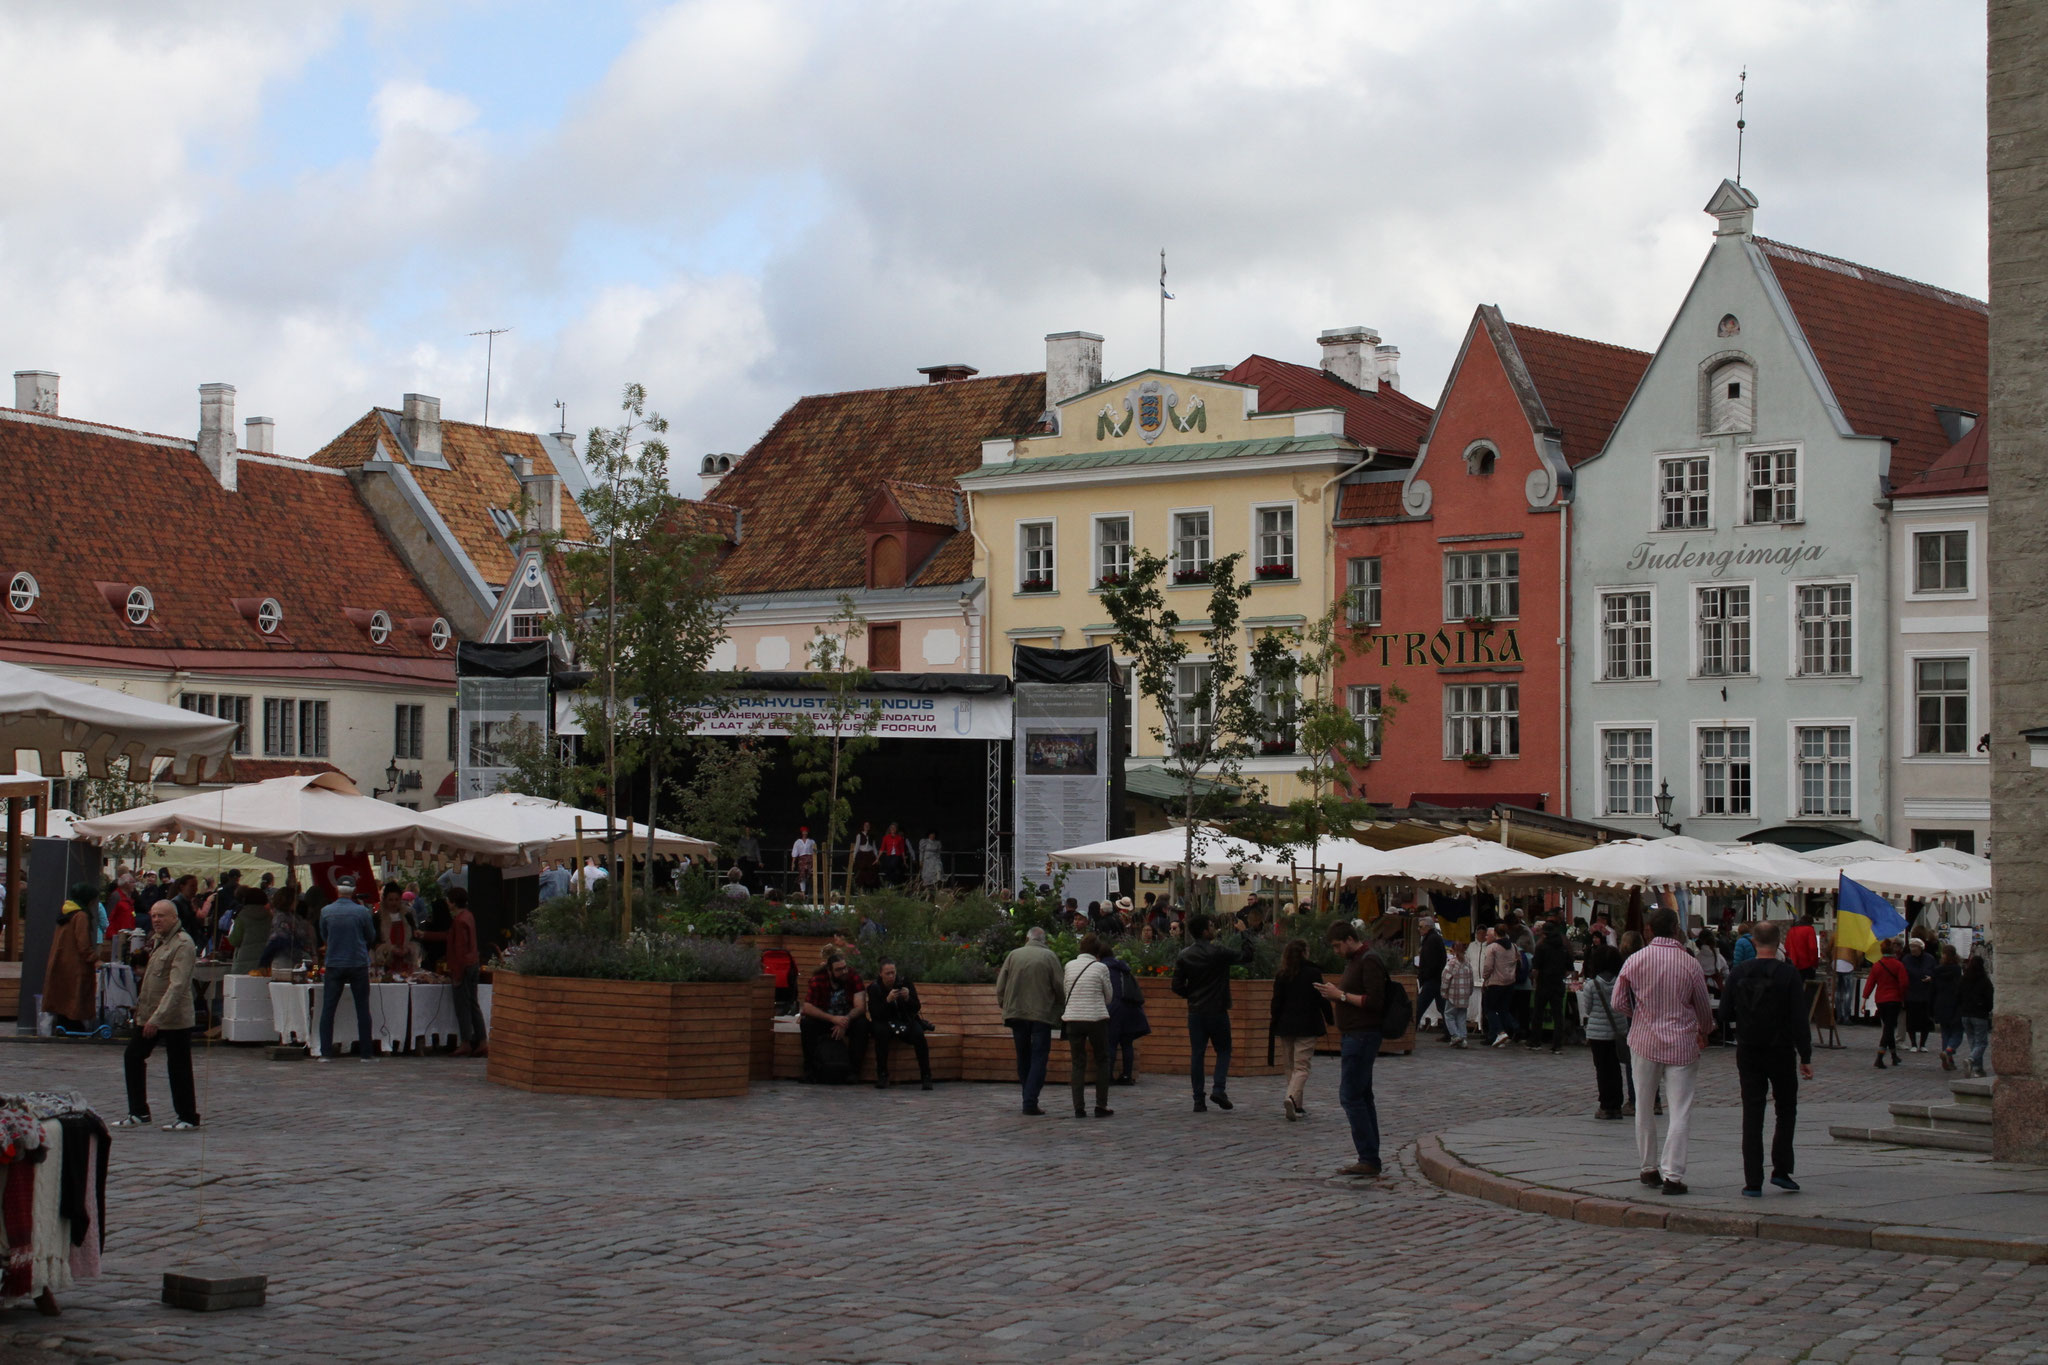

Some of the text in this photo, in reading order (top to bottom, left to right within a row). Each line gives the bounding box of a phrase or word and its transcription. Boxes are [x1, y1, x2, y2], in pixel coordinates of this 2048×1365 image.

[1626, 540, 1829, 577] Tudengimaja
[1371, 626, 1524, 667] TROIKA
[844, 695, 934, 709] ÜHNDUS
[881, 724, 936, 732] FOORUM
